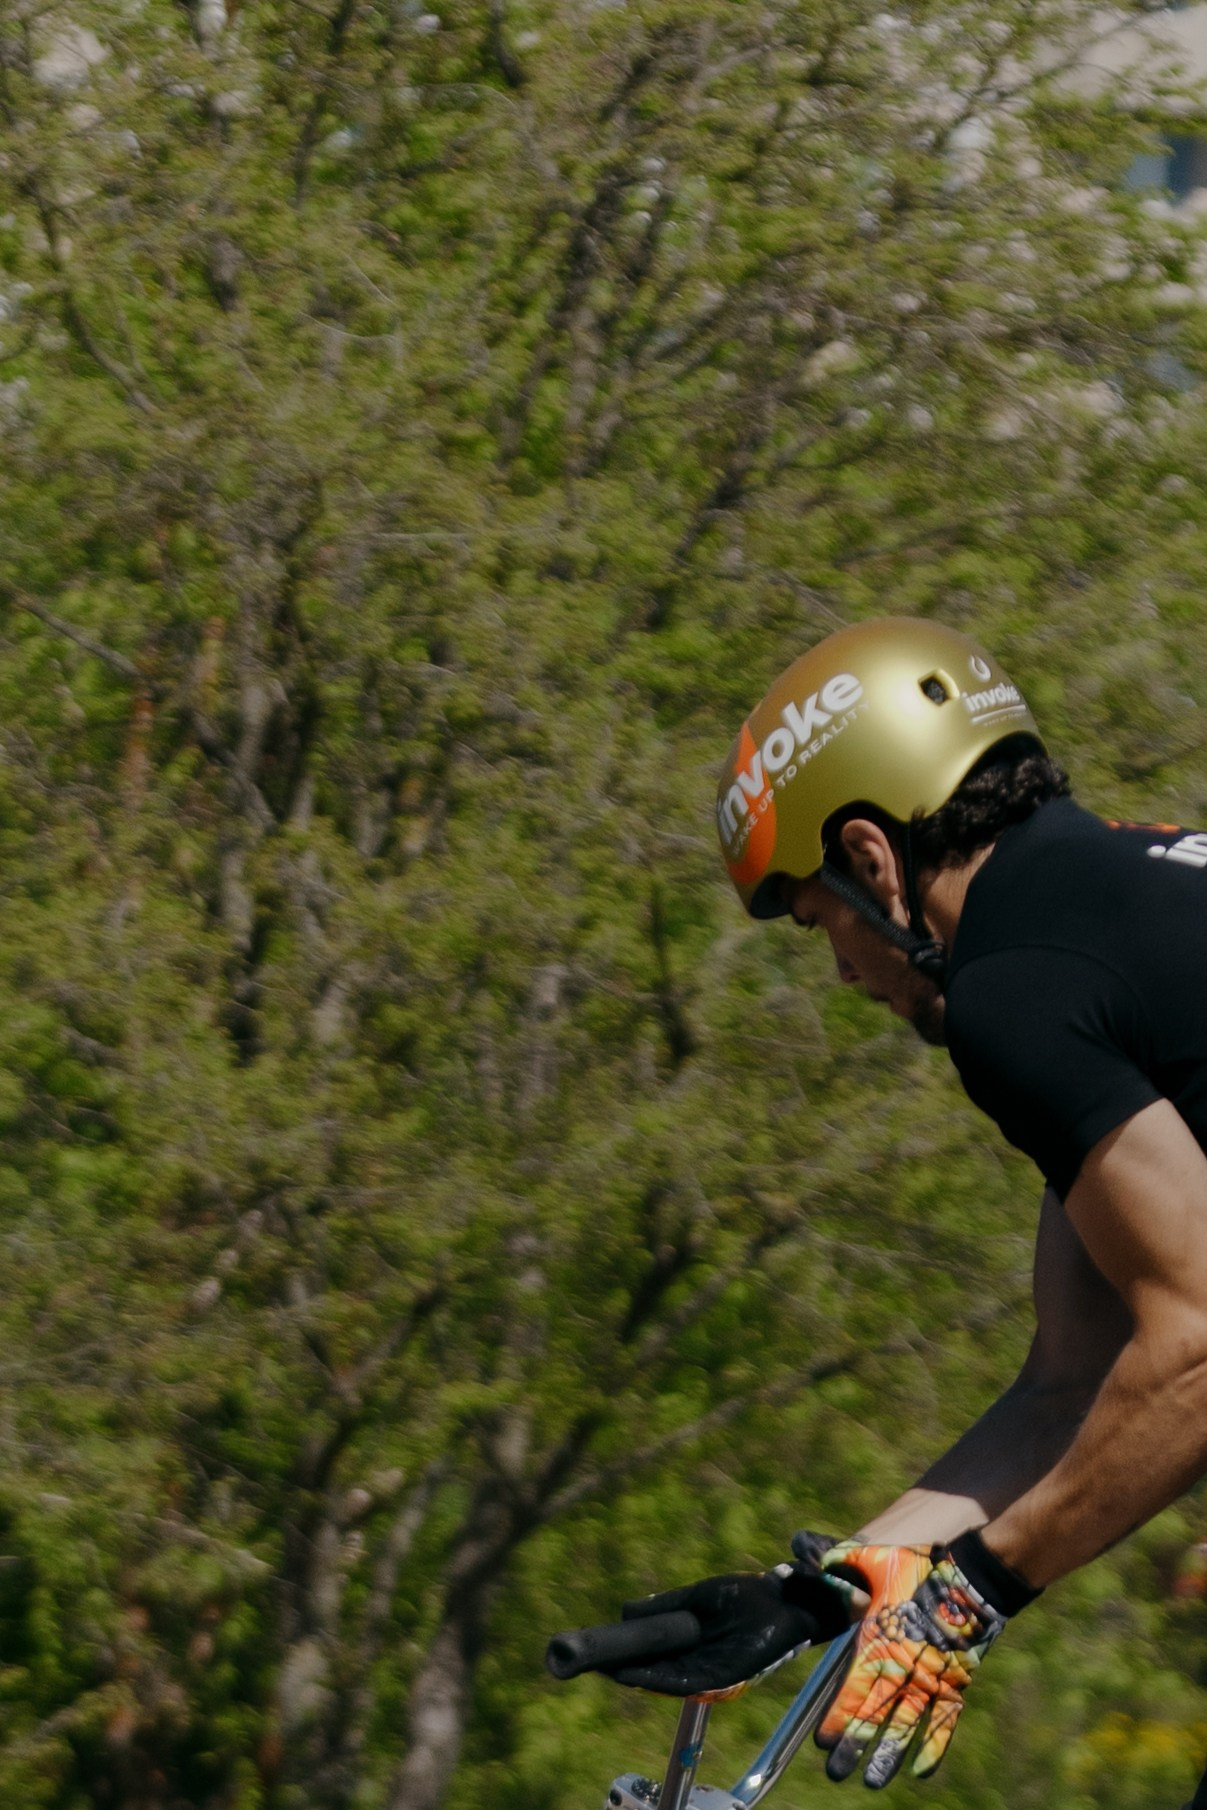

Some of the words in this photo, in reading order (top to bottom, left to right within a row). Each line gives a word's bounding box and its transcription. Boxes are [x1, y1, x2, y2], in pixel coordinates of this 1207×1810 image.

[758, 788, 774, 813] UP
[775, 764, 798, 788] TO
[799, 700, 872, 765] REALITY
